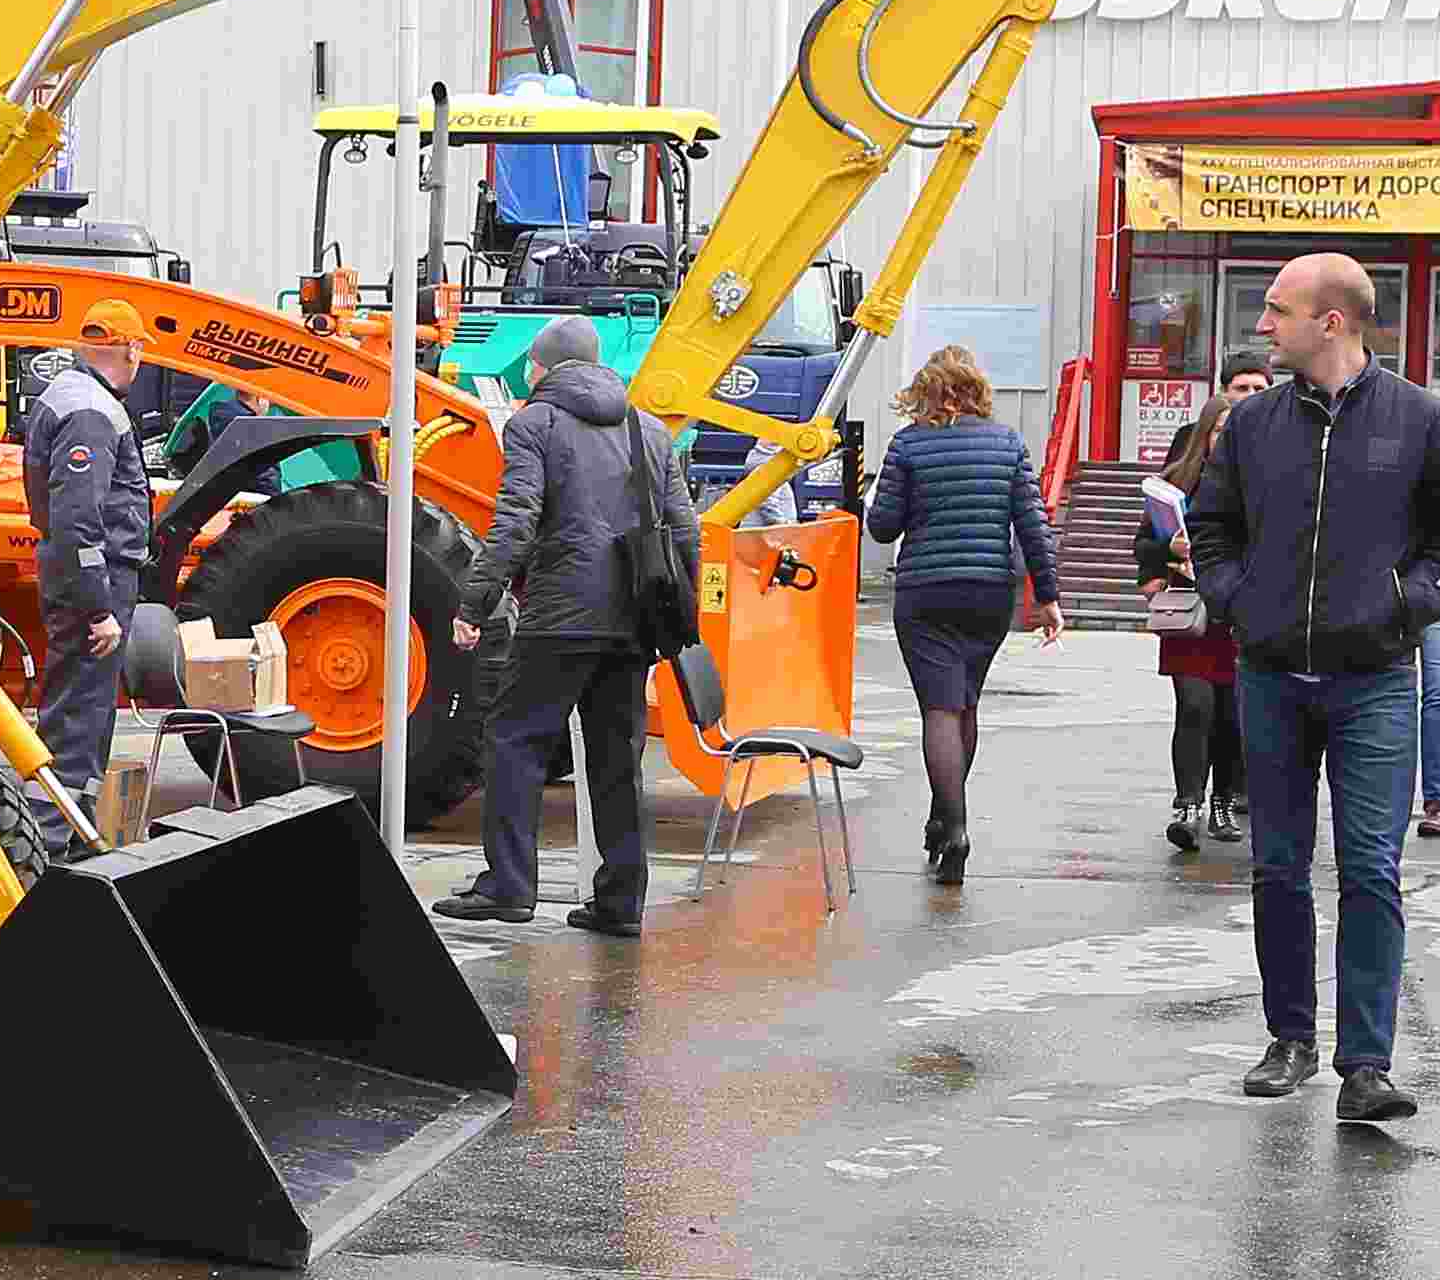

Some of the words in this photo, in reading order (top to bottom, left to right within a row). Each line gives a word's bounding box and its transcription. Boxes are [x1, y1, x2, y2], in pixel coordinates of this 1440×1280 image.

[1200, 175, 1346, 195] ТРАНСПОРТ
[1354, 176, 1370, 195] И
[1200, 198, 1380, 222] СПЕЦТЕХНИКА
[193, 320, 331, 372] РЫБИНЕЦ
[1138, 409, 1191, 424] ВХОД
